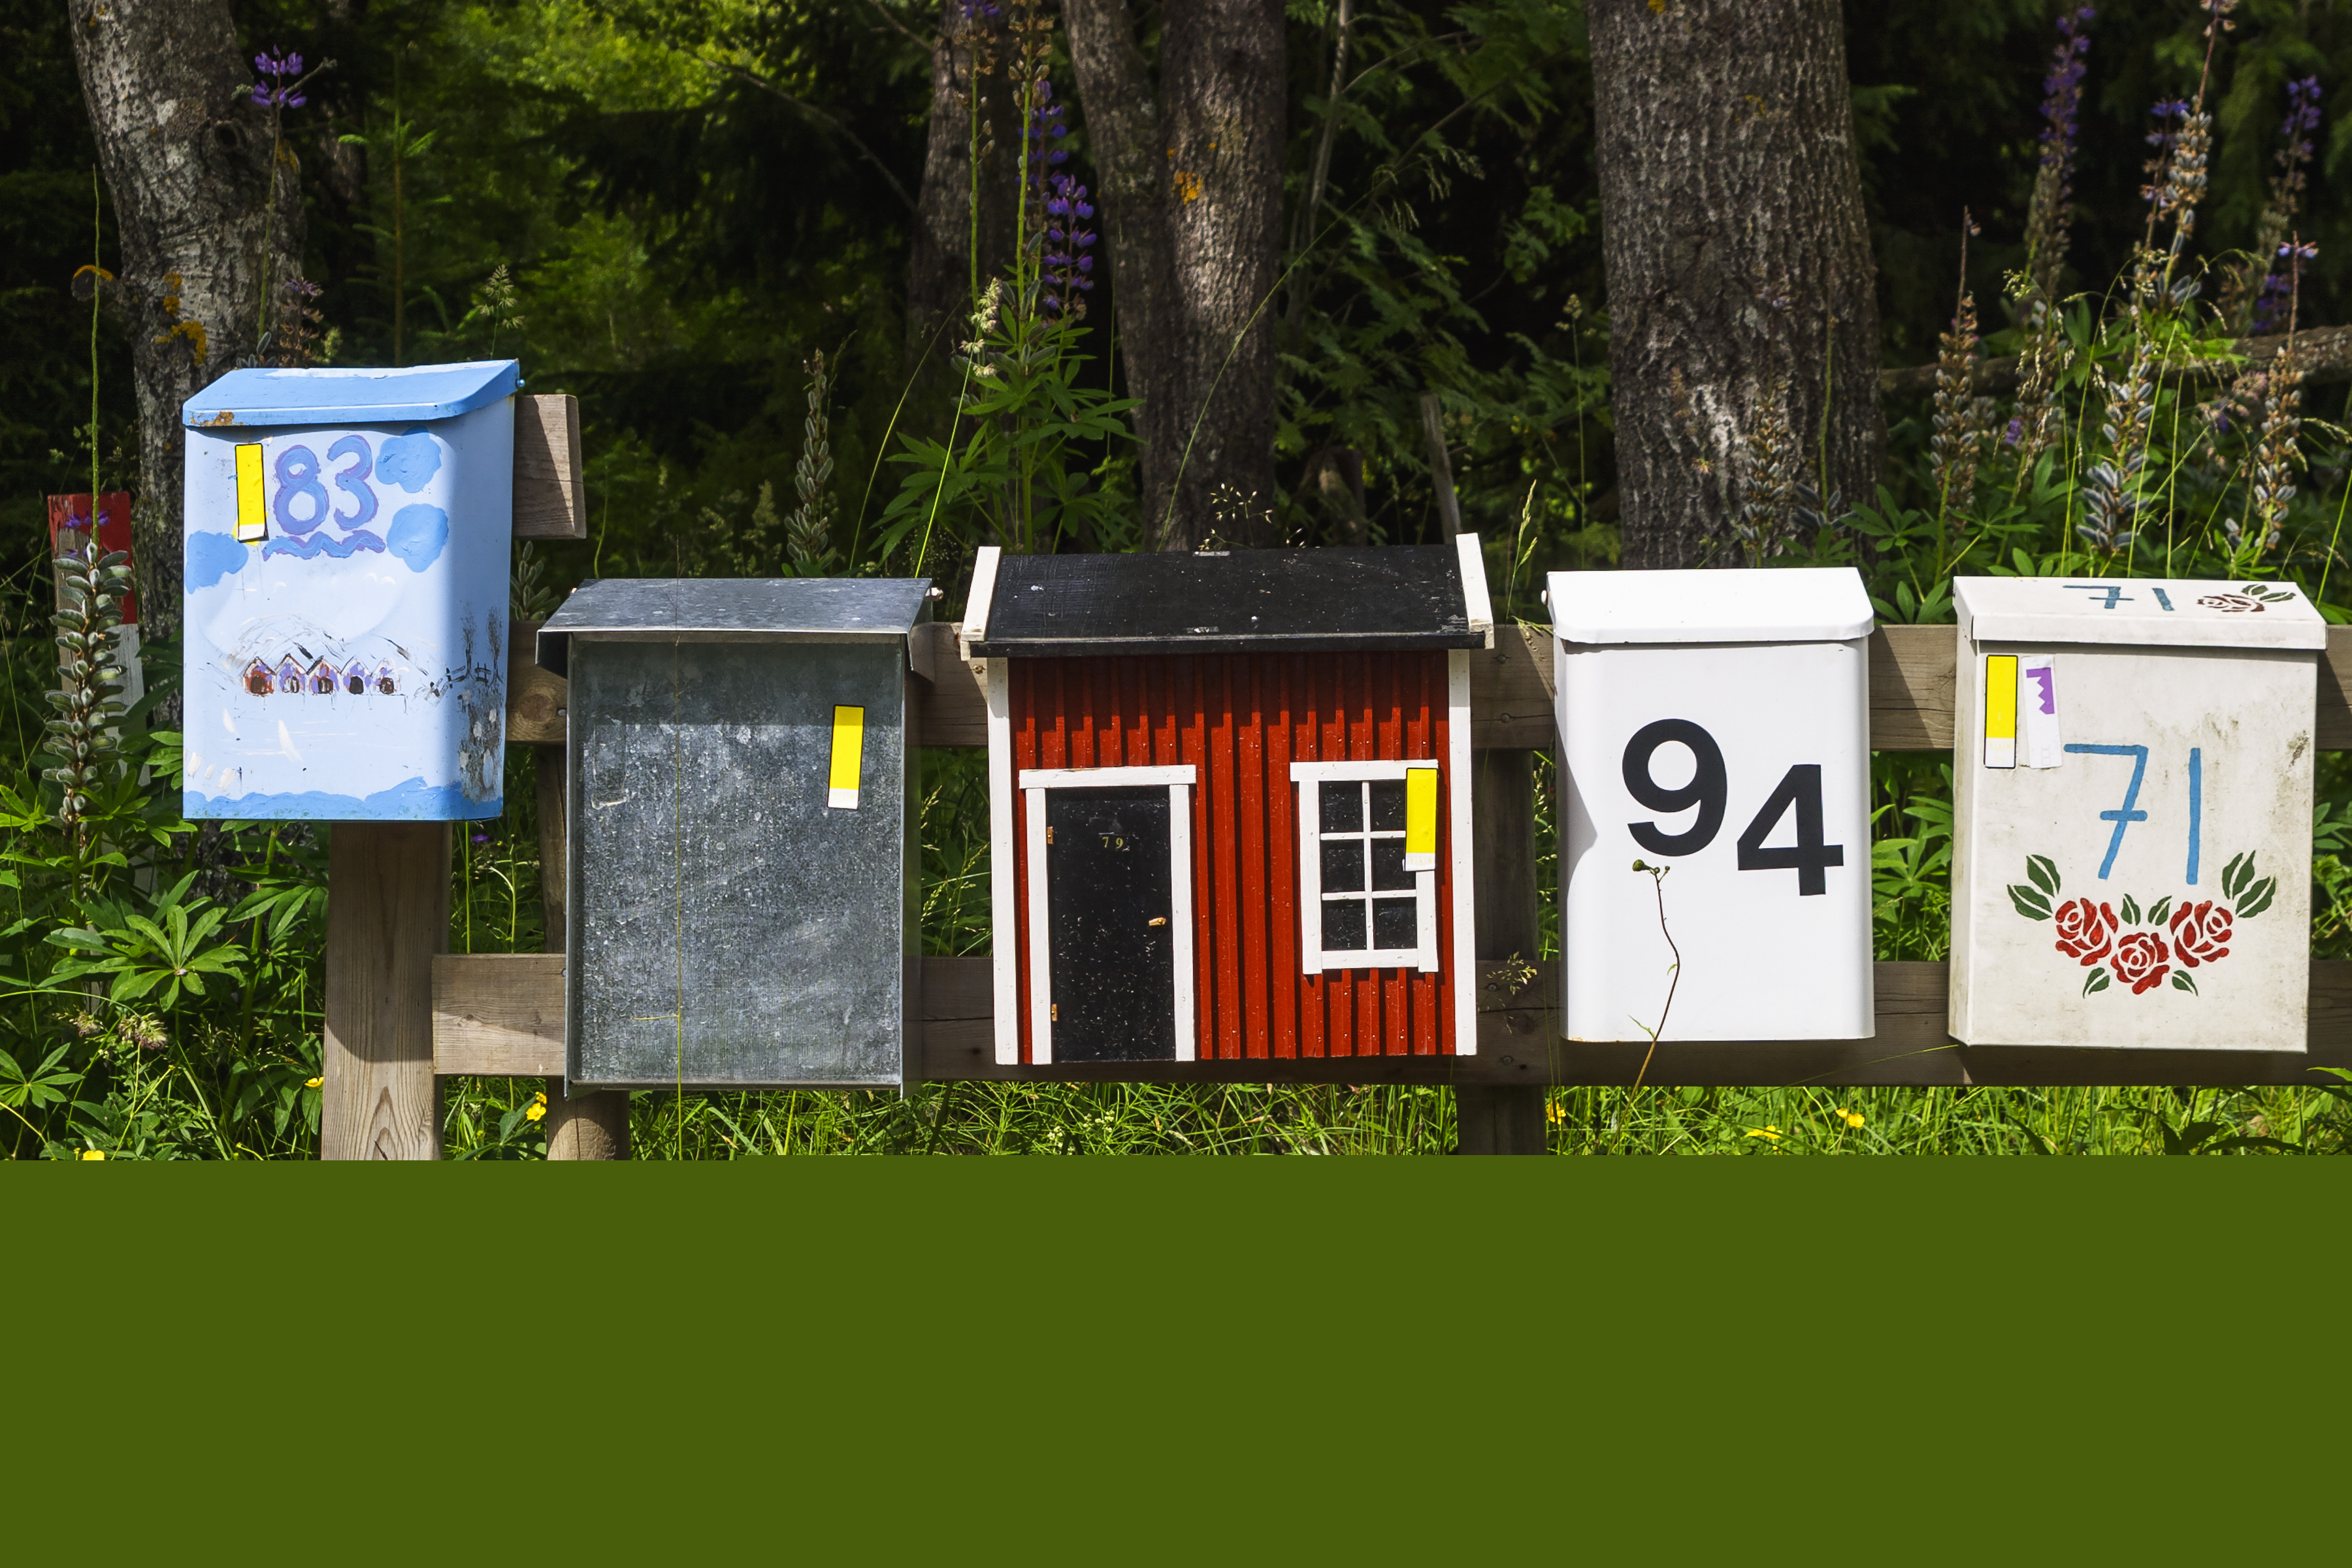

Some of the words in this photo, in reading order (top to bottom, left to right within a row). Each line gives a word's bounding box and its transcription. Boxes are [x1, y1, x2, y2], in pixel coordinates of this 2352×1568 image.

[274, 434, 379, 535] 83
[2063, 585, 2175, 611] 71
[1102, 836, 1124, 849] 79
[1622, 719, 1844, 896] 94
[2063, 743, 2201, 885] 71
